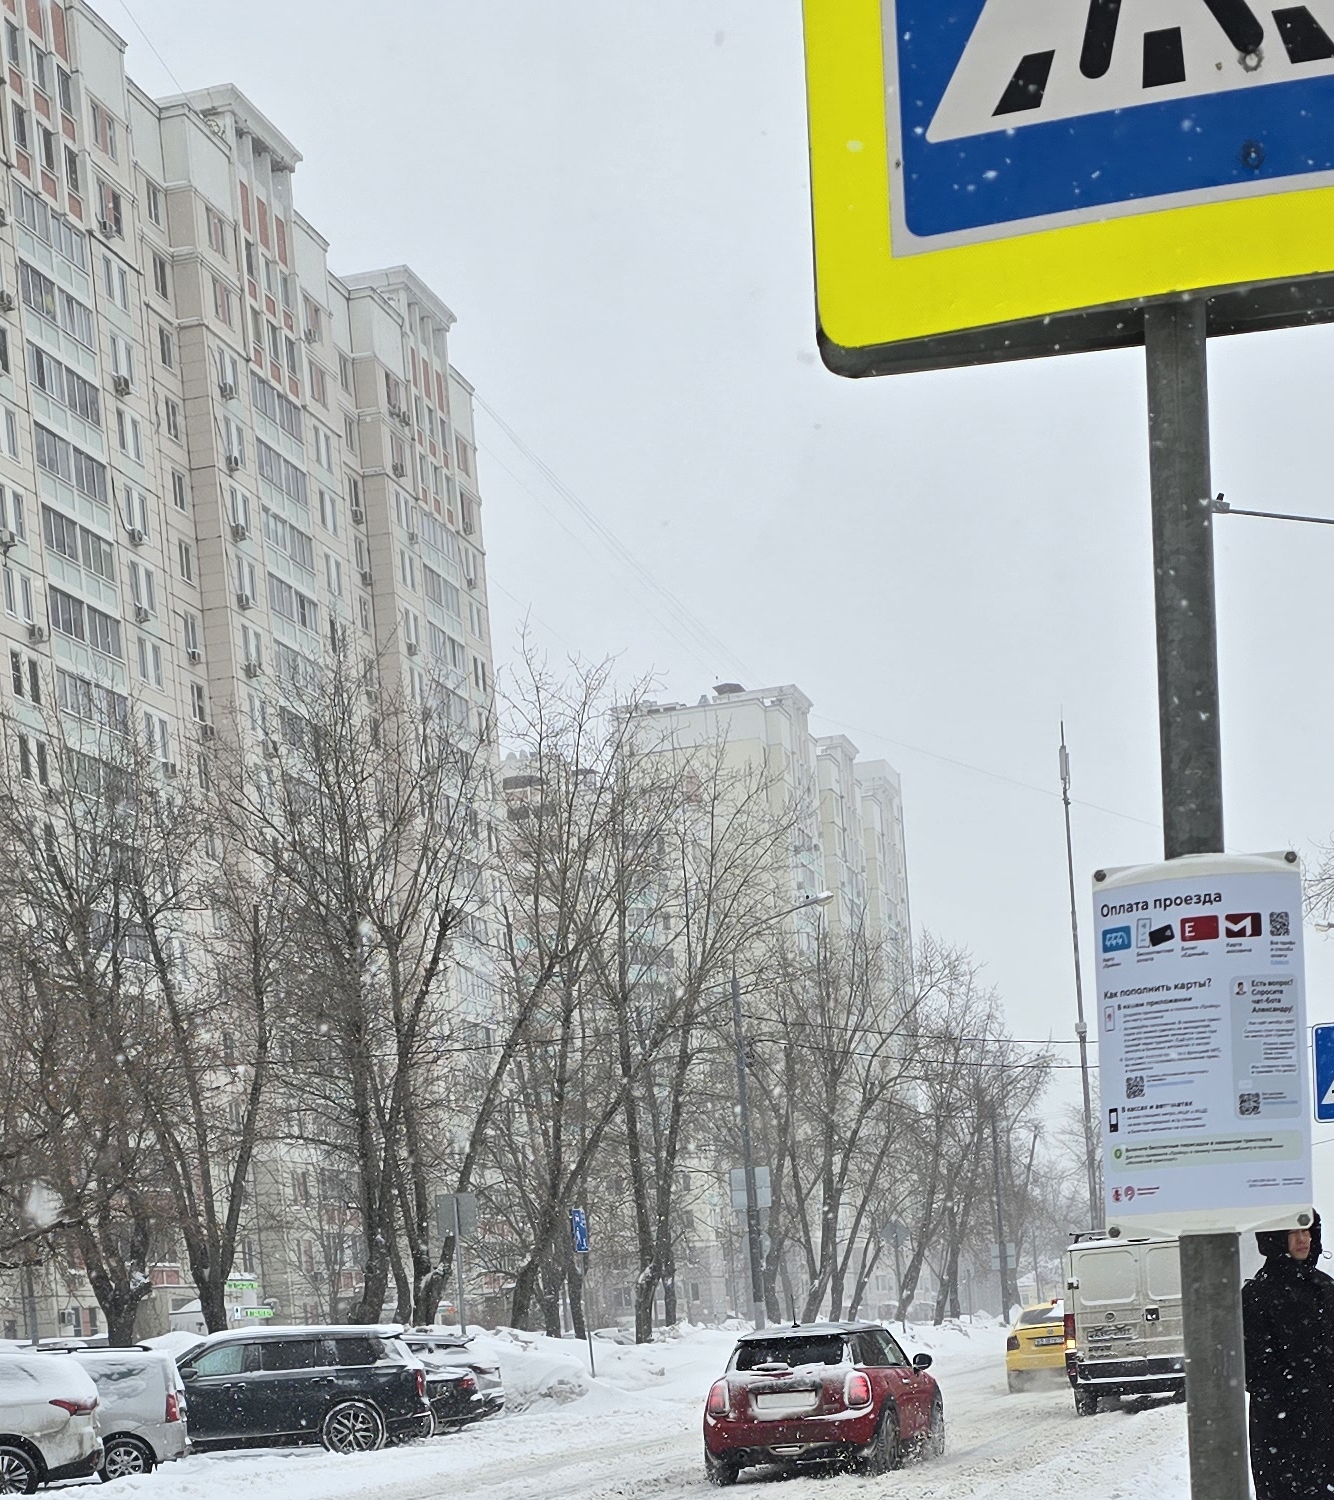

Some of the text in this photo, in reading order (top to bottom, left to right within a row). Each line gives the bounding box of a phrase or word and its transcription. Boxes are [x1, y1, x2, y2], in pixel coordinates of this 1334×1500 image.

[1100, 892, 1223, 918] Оплата проезда
[1104, 978, 1212, 1000] Как пополнить карты?
[1251, 988, 1284, 996] Спросите
